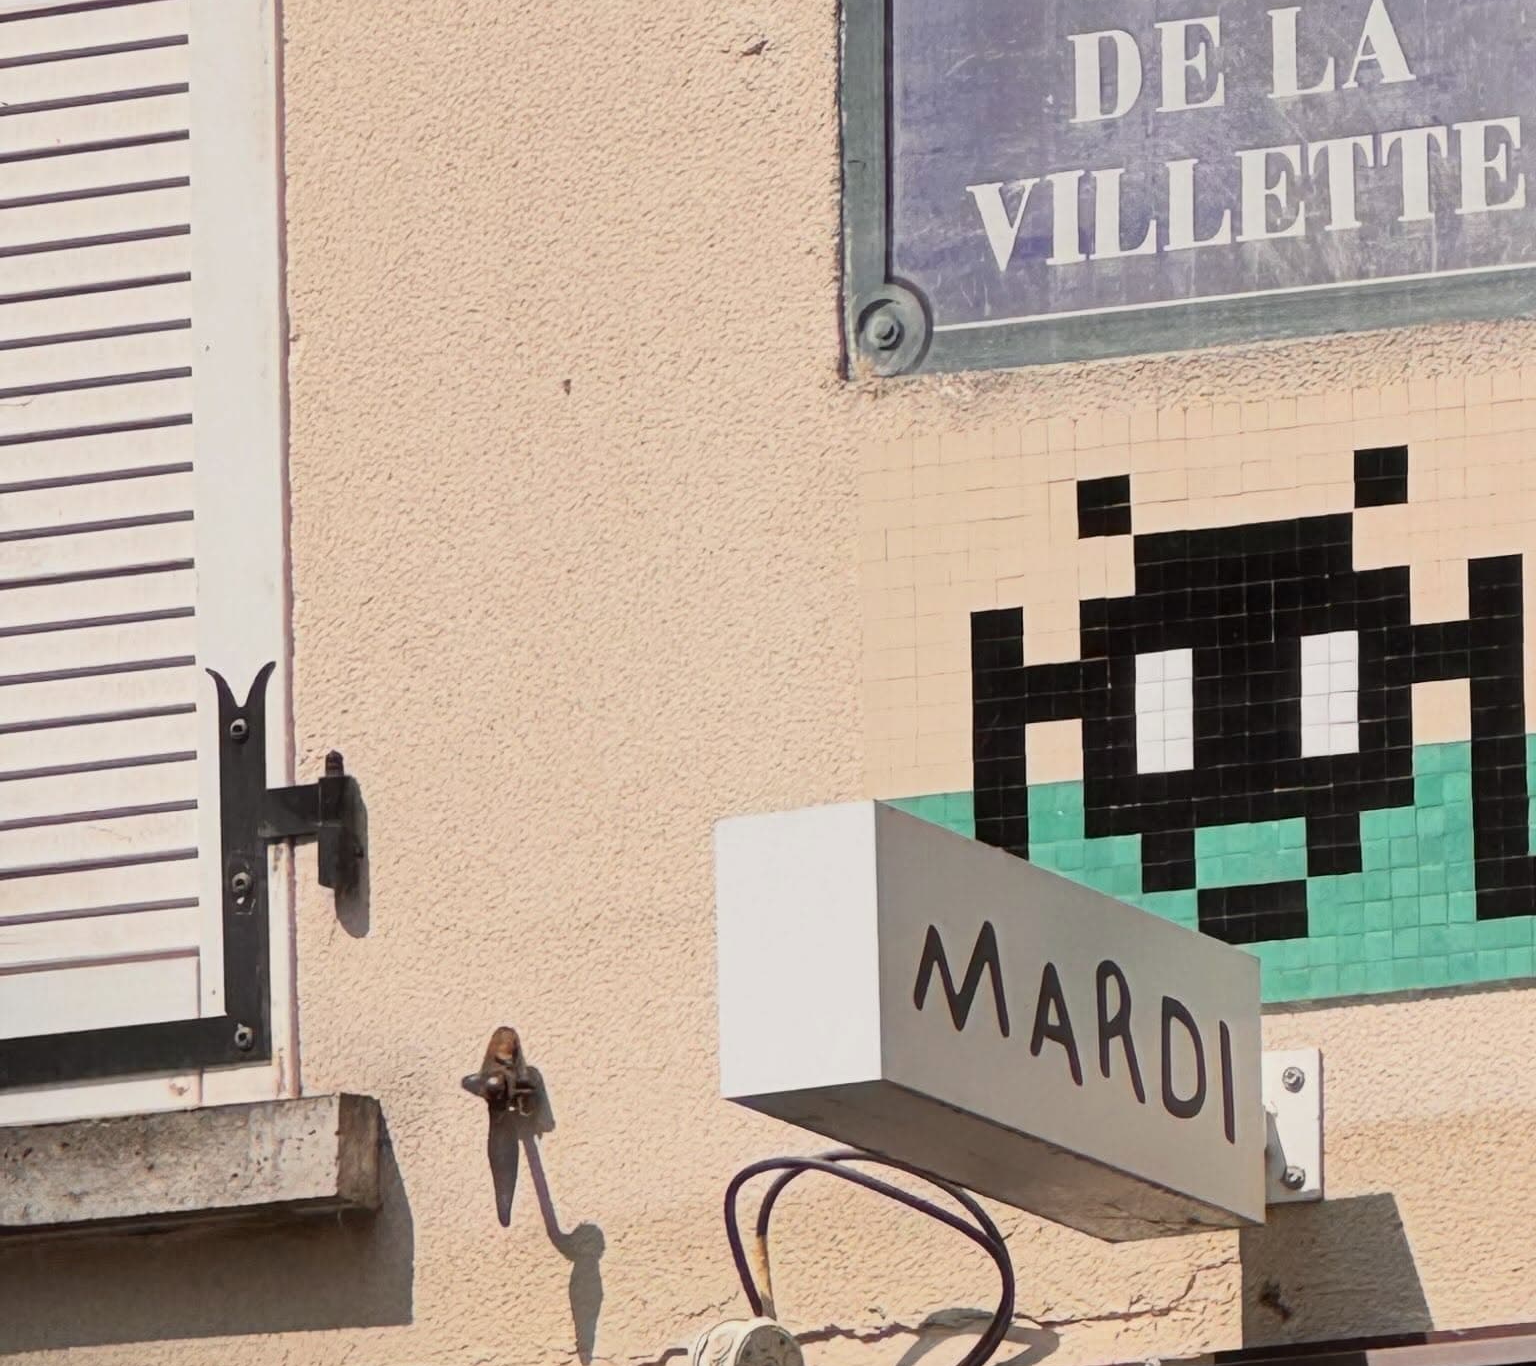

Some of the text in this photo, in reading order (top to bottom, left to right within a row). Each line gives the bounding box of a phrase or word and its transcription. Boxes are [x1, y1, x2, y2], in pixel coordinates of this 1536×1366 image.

[1068, 16, 1228, 124] DE
[966, 116, 1528, 274] VILLETTE
[912, 919, 1236, 1145] MARDI
